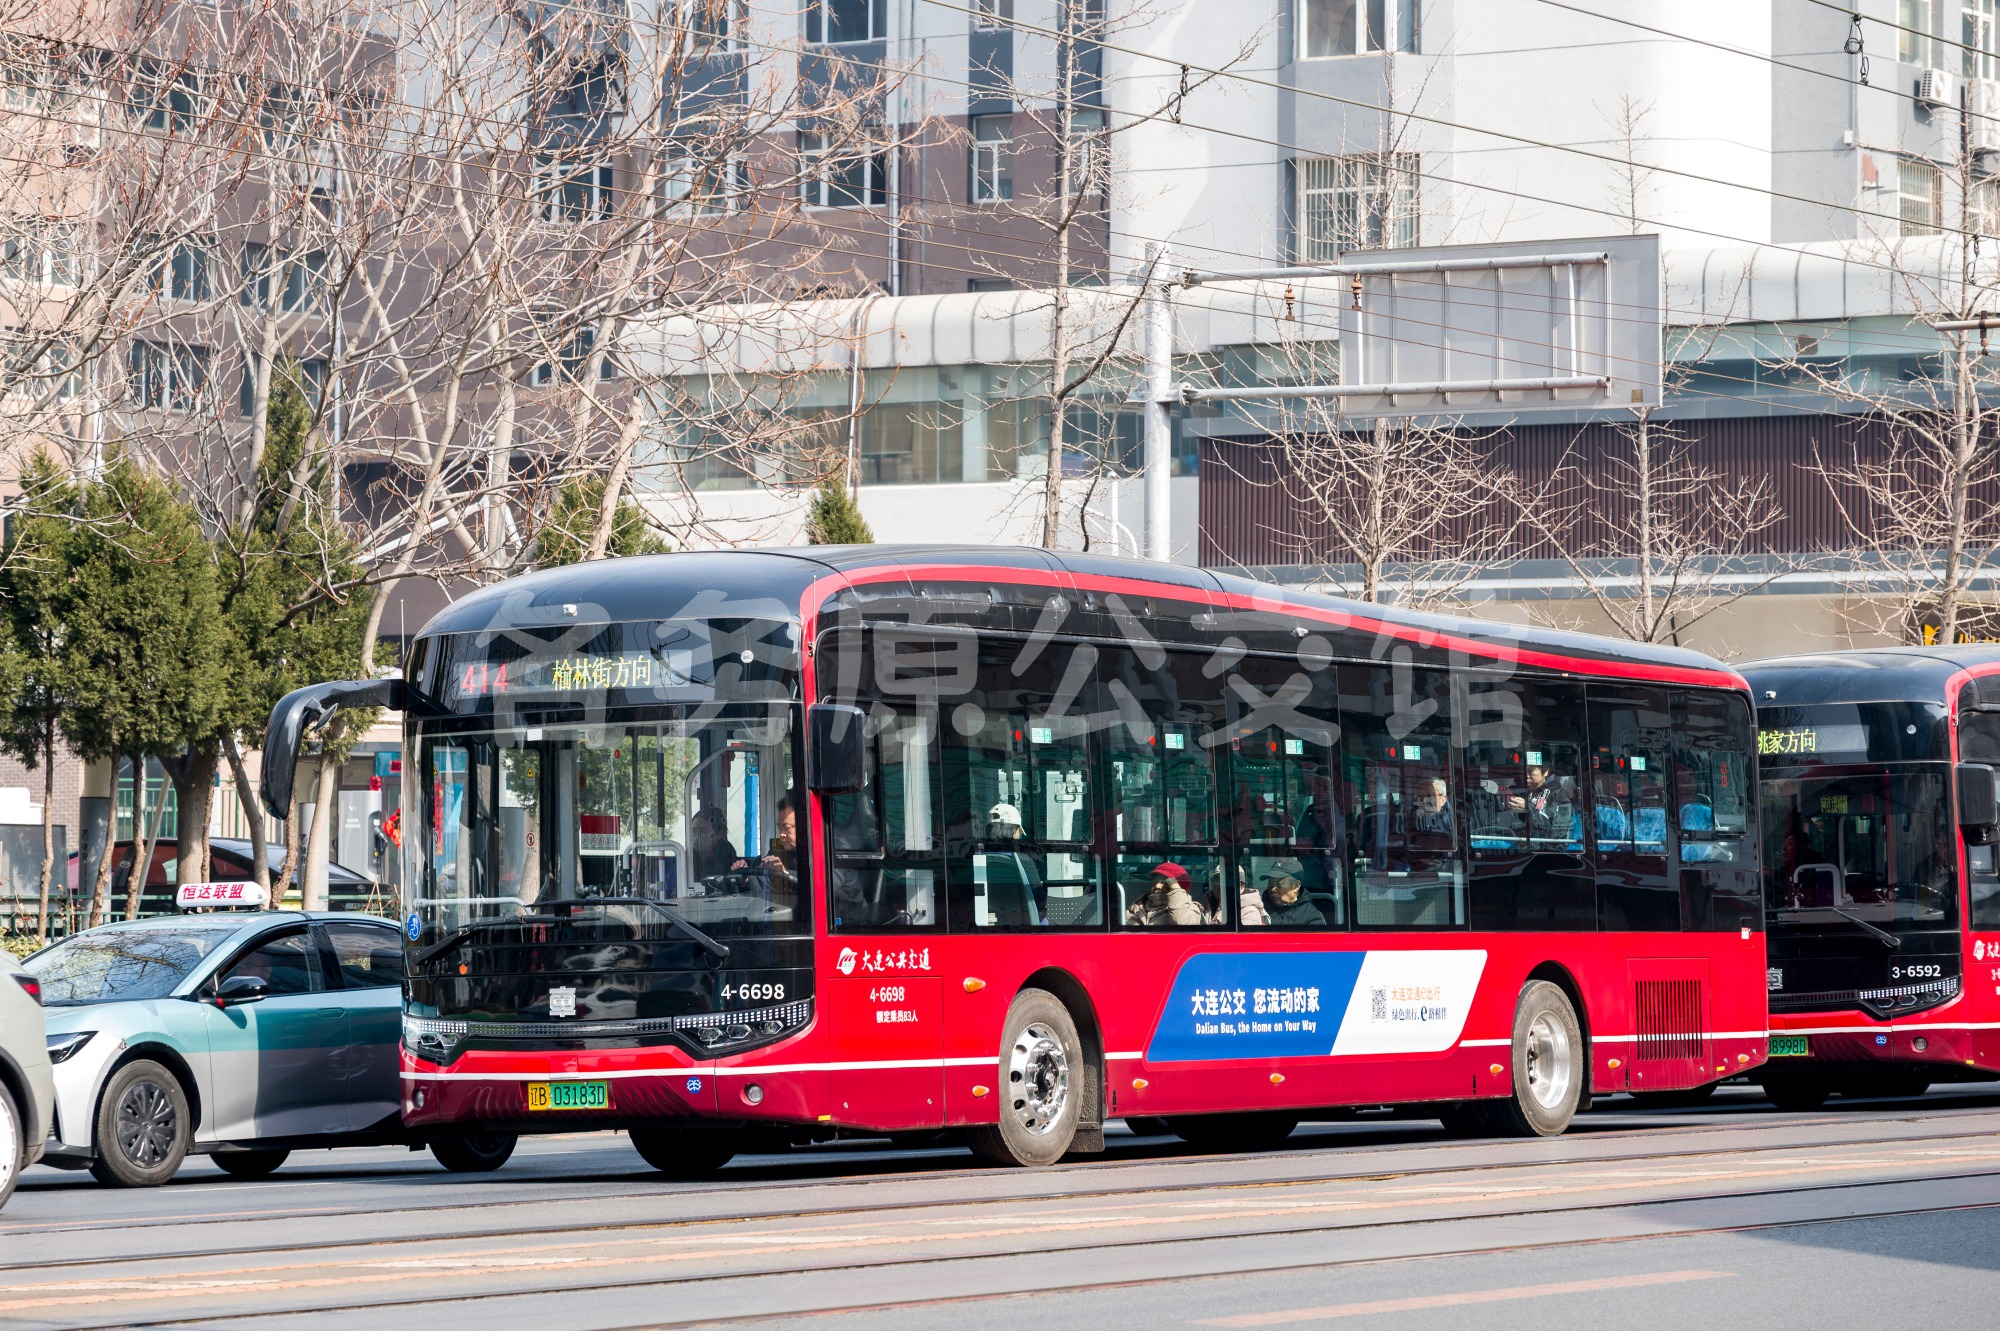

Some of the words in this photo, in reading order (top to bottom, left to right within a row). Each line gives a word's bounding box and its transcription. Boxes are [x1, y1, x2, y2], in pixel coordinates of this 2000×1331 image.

[461, 664, 508, 694] 414
[552, 654, 651, 692] 榆林街方向
[183, 883, 245, 900] 恒达联盟
[1891, 964, 1942, 979] 3-6592
[720, 983, 785, 1000] 4-6698
[869, 985, 905, 1003] 4-6698
[1191, 988, 1246, 1016] 大连公交
[1253, 986, 1320, 1014] 您流动的家
[876, 1009, 918, 1023] 额定乘员83人
[1195, 1022, 1218, 1034] Dalian
[1220, 1022, 1236, 1036] Bus,
[1238, 1021, 1250, 1033] the
[1251, 1021, 1271, 1033] Home
[1273, 1022, 1282, 1032] on
[1284, 1020, 1300, 1032] Your
[1302, 1020, 1316, 1033] Way
[553, 1085, 605, 1106] 03183D
